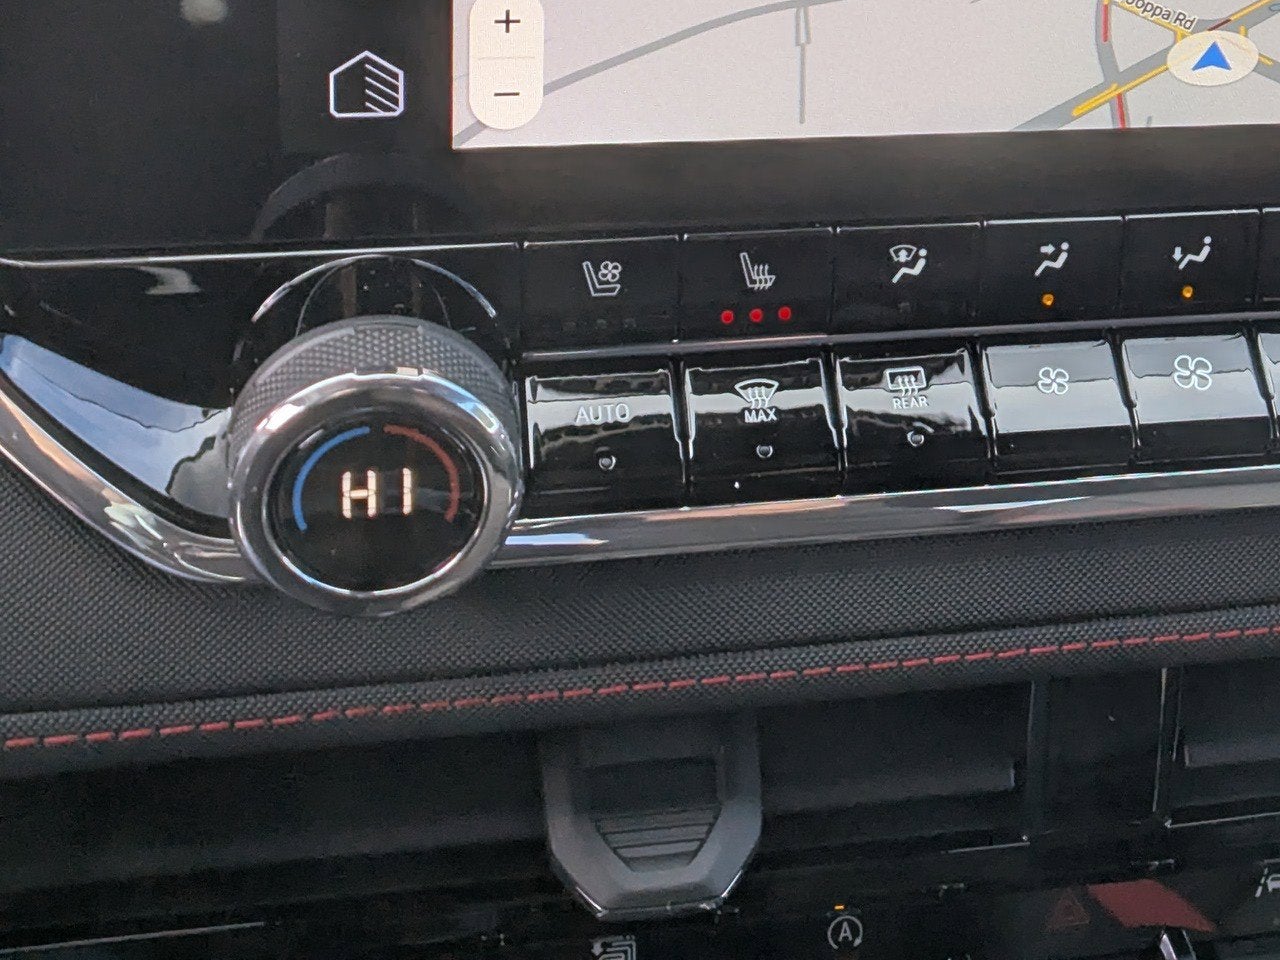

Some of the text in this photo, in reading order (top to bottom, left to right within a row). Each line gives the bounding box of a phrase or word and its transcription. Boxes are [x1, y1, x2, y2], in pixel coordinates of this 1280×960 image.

[1174, 12, 1196, 29] Rd
[892, 396, 929, 410] REAR
[574, 403, 630, 424] AUTO
[745, 408, 777, 422] MAX
[342, 467, 412, 519] HI
